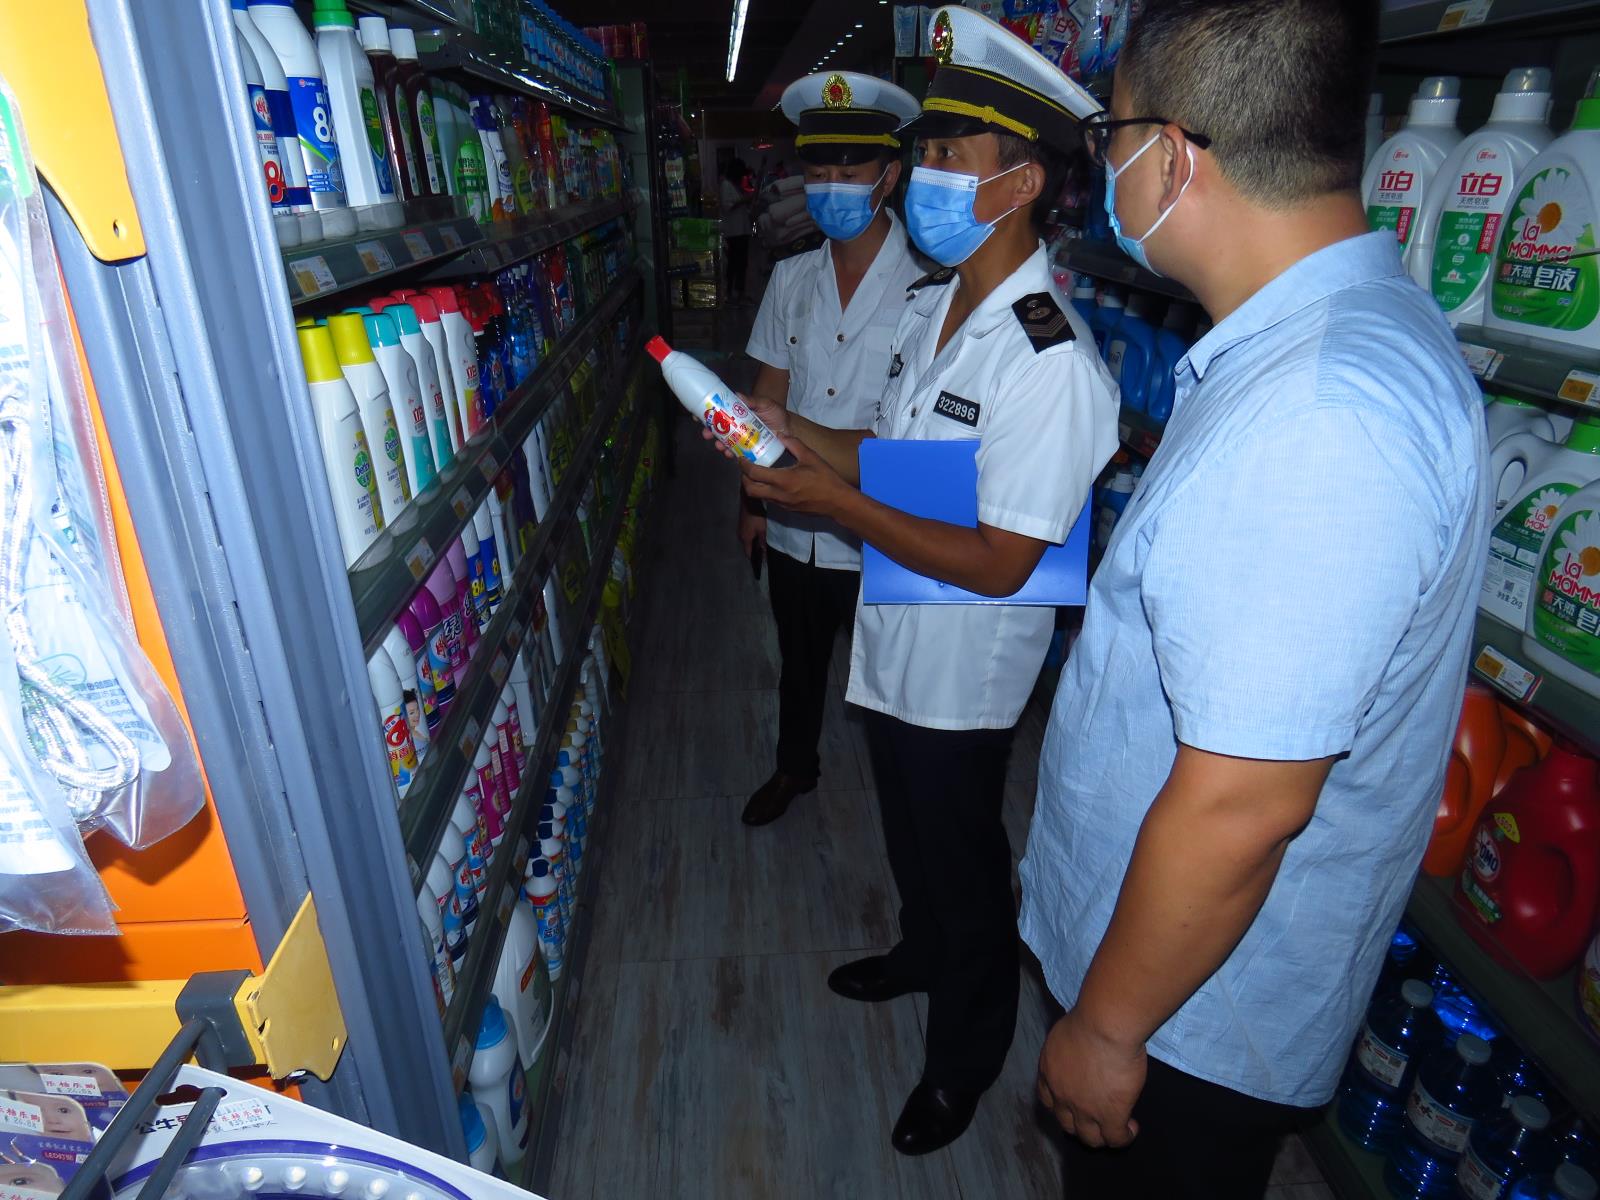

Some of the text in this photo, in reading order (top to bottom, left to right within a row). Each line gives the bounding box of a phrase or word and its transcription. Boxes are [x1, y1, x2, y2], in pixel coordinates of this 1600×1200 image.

[313, 107, 333, 143] 8
[264, 160, 286, 203] 8
[1378, 170, 1414, 191] 立白
[1457, 172, 1503, 196] 立白
[938, 396, 976, 421] 322896
[1577, 607, 1600, 636] 皂
